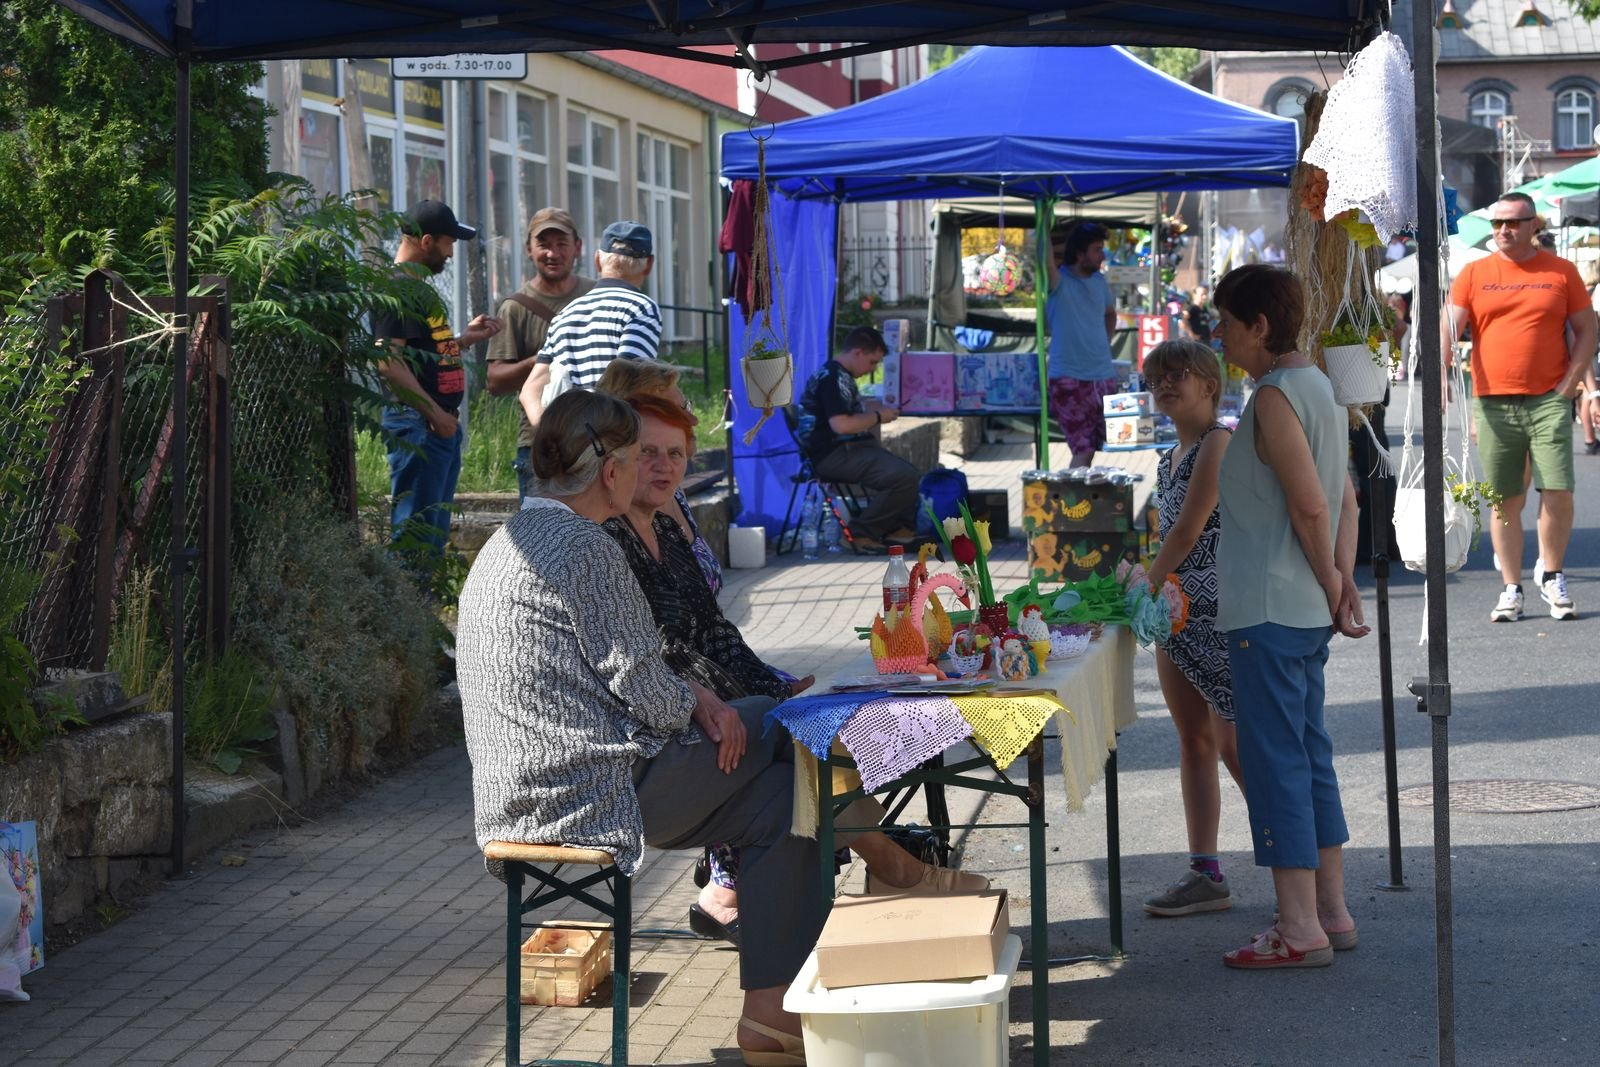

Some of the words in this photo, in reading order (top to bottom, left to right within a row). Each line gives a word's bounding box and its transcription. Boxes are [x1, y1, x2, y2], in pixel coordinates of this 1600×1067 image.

[406, 62, 415, 70] w
[419, 60, 451, 73] godz.
[455, 60, 512, 71] 7.30-17.00
[1482, 283, 1553, 291] diverse
